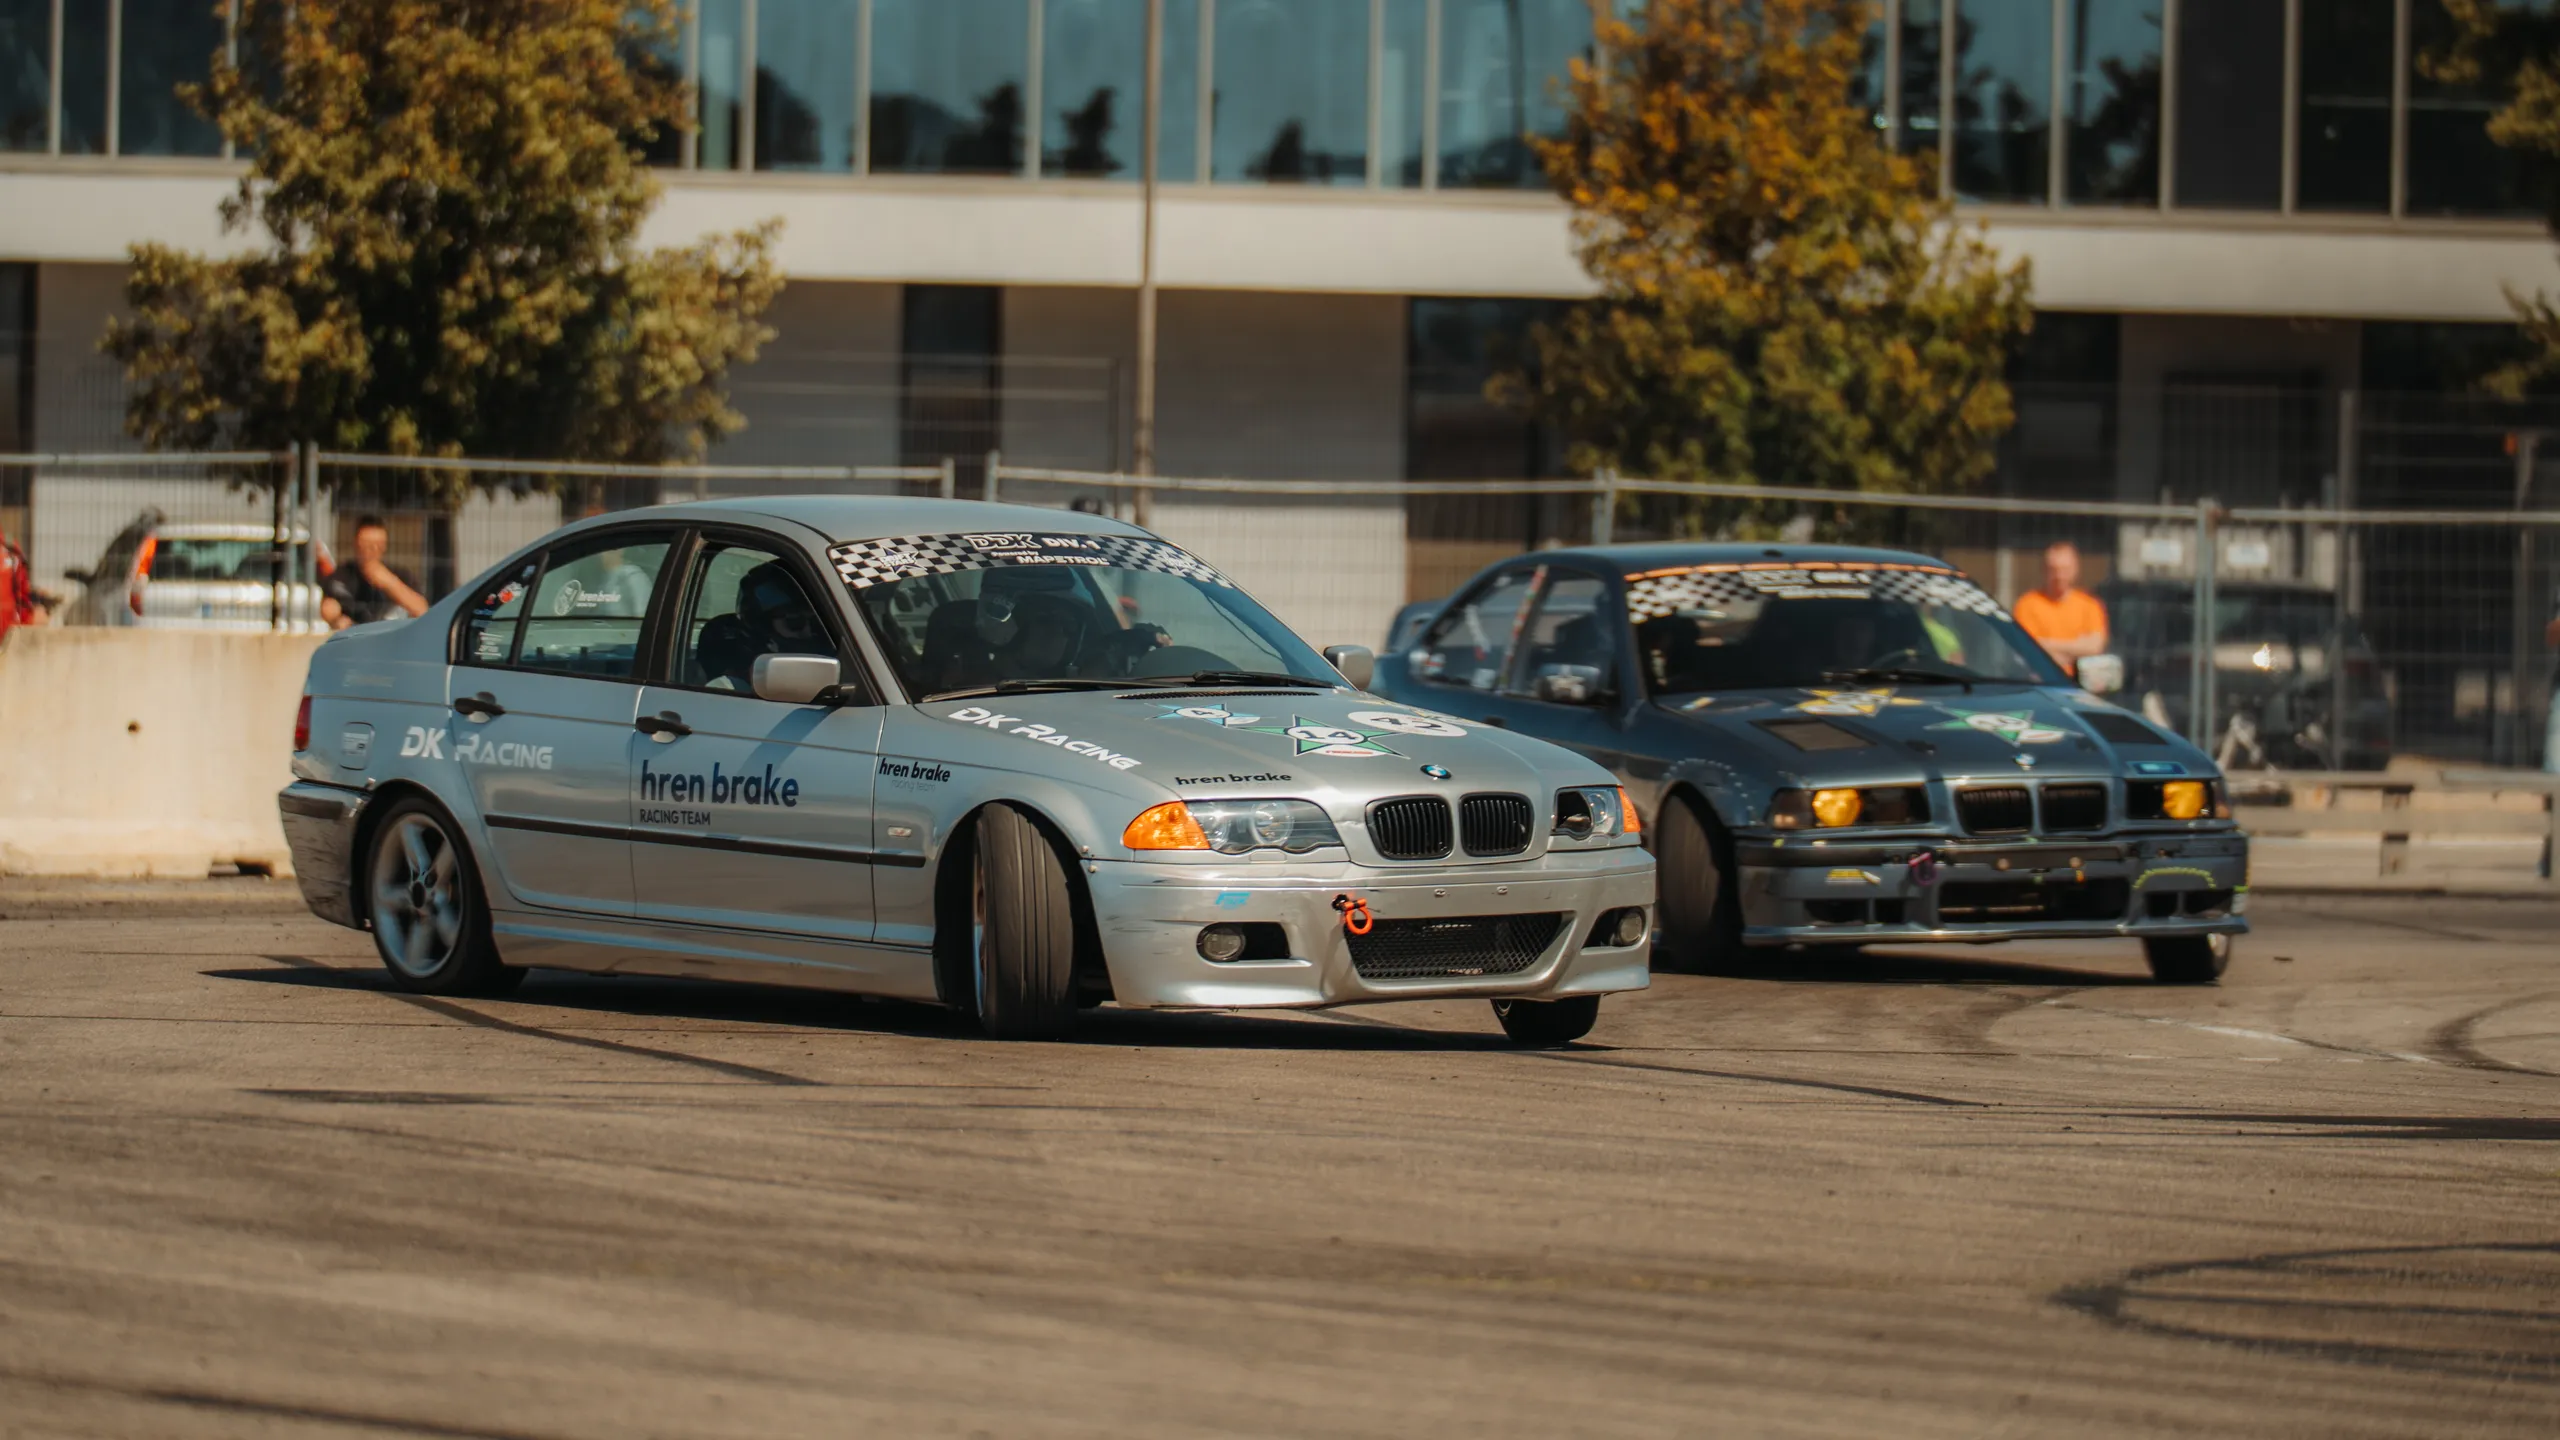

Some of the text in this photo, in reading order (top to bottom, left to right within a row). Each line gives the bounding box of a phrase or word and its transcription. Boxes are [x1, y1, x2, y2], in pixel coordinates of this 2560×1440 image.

[963, 534, 1042, 551] DDK
[949, 707, 1141, 770] DK RACING
[1296, 730, 1358, 740] 14
[400, 726, 447, 760] DK
[453, 731, 554, 770] RACING
[879, 757, 951, 782] hren brake
[1175, 773, 1292, 786] hren brake
[640, 759, 799, 807] hren brake
[640, 809, 711, 826] RACING TEAM
